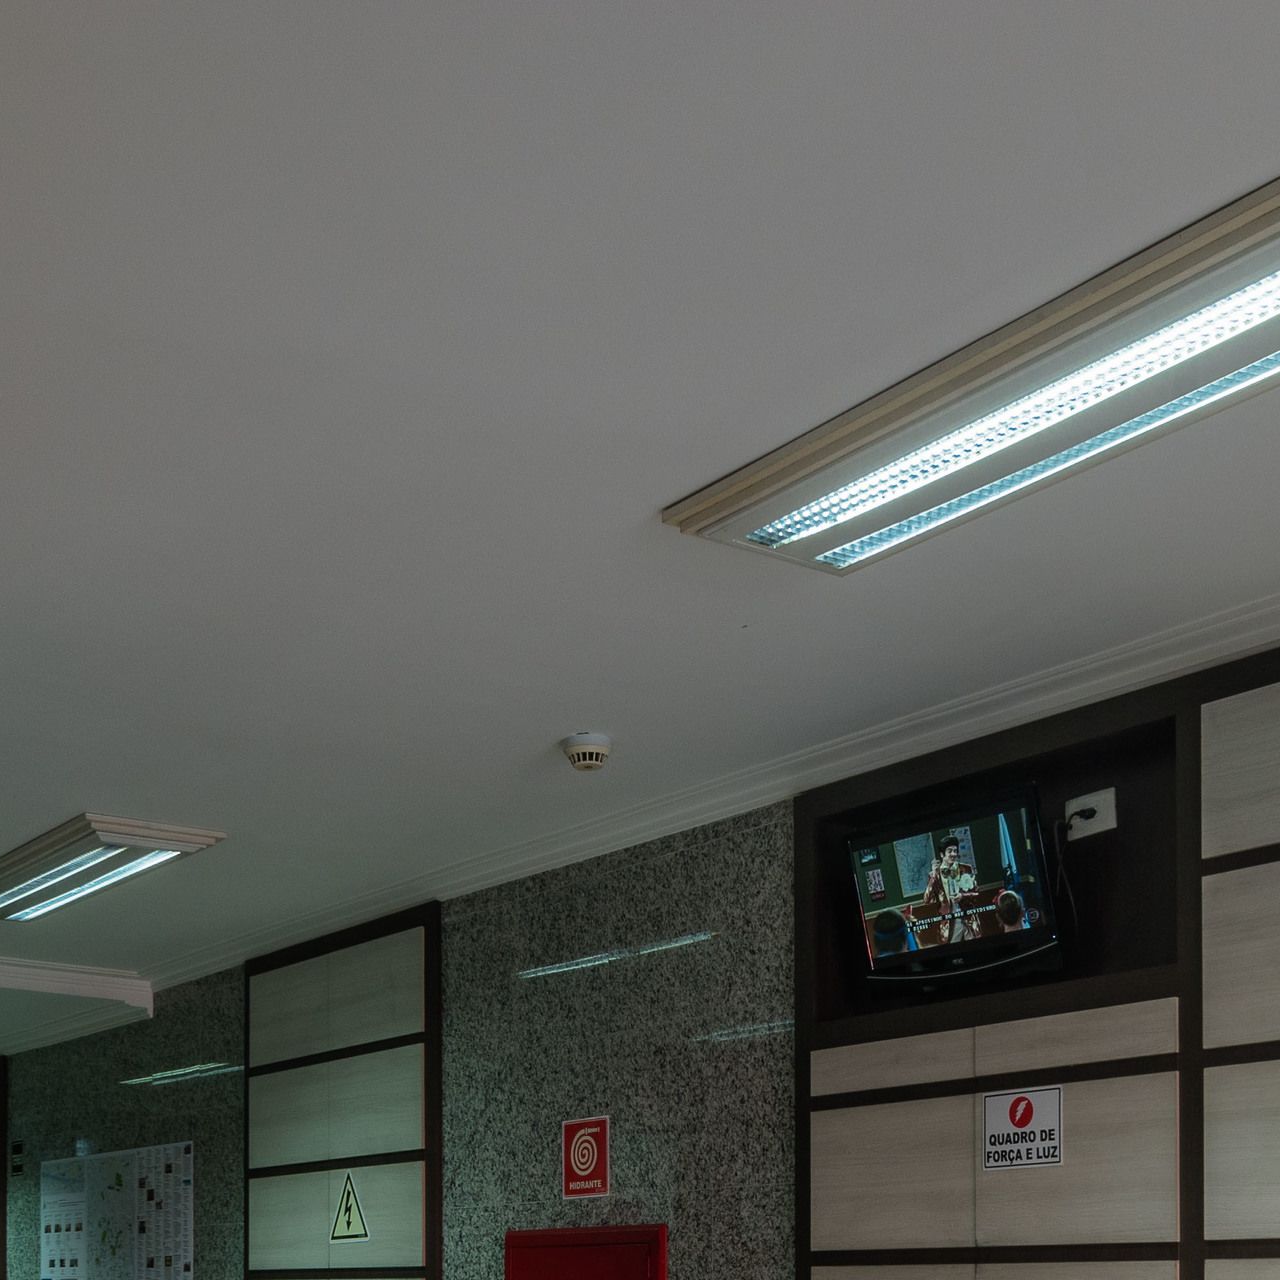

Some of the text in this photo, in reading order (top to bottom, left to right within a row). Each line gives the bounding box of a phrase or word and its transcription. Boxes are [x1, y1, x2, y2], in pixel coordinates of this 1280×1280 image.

[988, 1128, 1056, 1147] QUADRO DE
[986, 1145, 1058, 1166] FORÇA E LUZ
[569, 1180, 603, 1191] HIDRANTE
